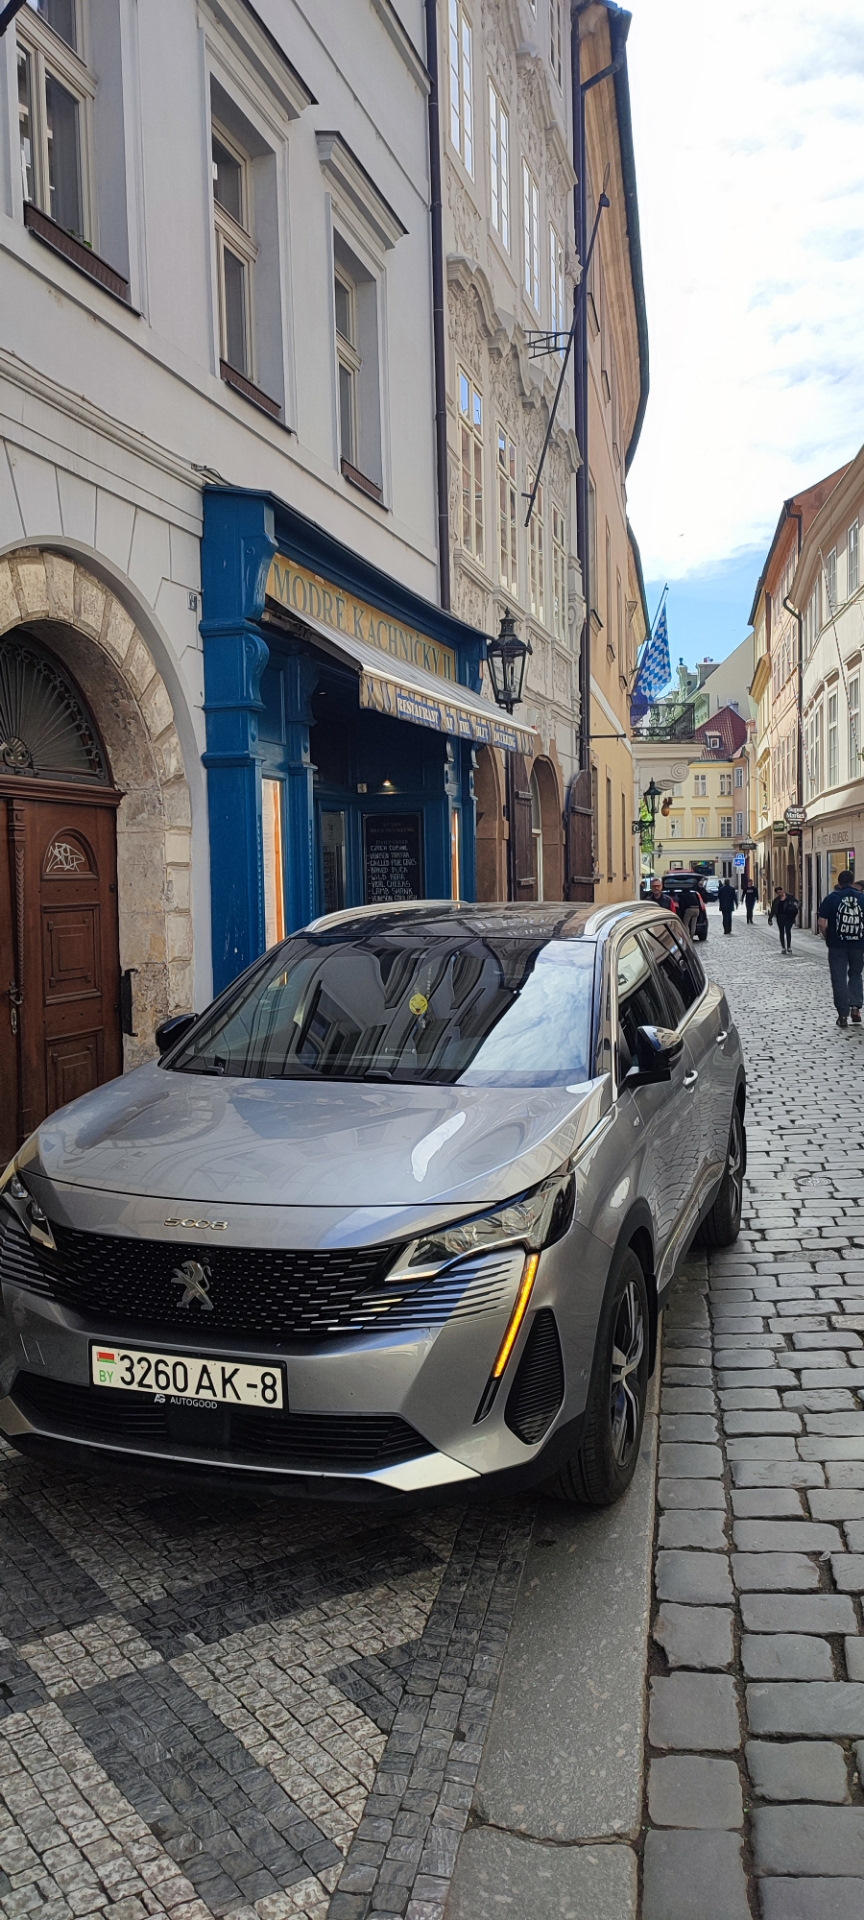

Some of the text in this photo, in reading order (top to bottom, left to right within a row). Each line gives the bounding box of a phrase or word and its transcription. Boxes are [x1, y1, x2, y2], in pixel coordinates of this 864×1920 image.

[273, 562, 347, 630] MODRÉ
[443, 653, 452, 681] II
[397, 697, 439, 724] RESTAURANT
[786, 811, 805, 819] Market
[841, 923, 860, 934] CITY
[163, 1217, 229, 1231] 5008
[99, 1369, 114, 1384] BY
[119, 1354, 278, 1405] 3260 AK-8
[170, 1396, 218, 1409] AUTOGOOD
